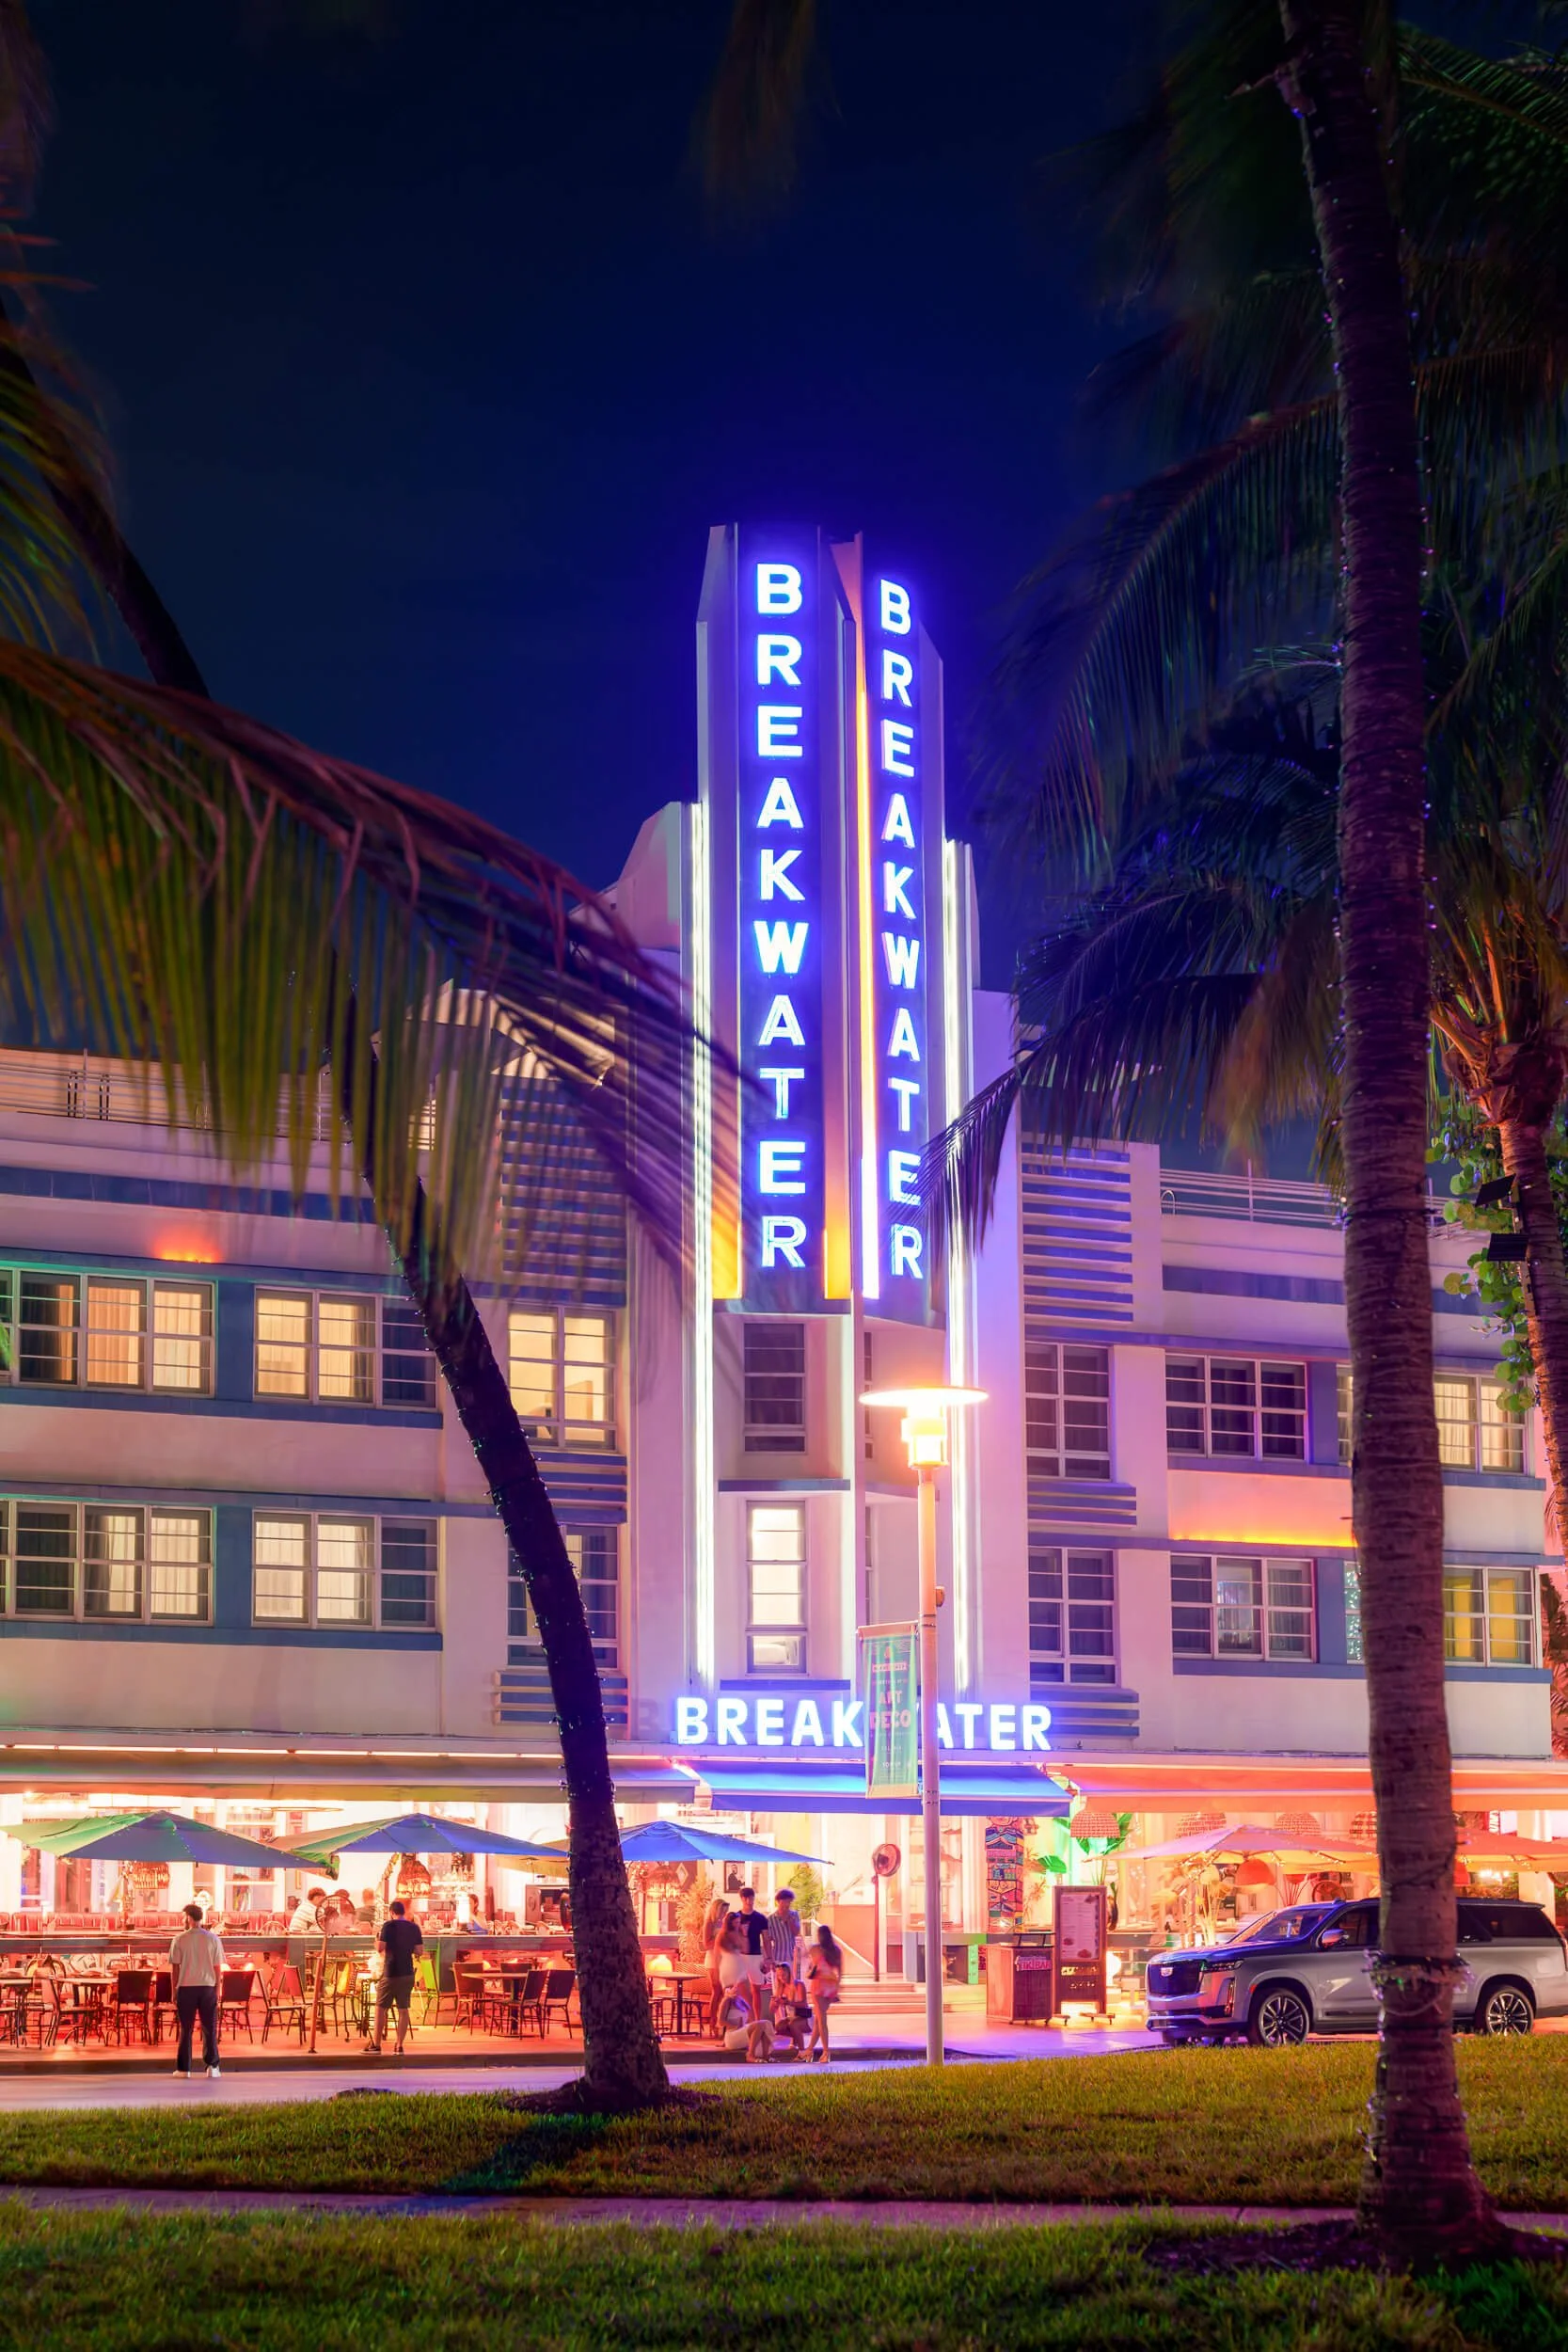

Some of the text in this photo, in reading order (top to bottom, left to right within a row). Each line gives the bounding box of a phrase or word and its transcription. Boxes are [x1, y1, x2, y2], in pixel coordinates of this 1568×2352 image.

[754, 563, 809, 1268] BREAKWATER
[880, 579, 923, 1279] BREAKWATER
[676, 1696, 1053, 1752] BREAKATER
[869, 1708, 911, 1730] DECO
